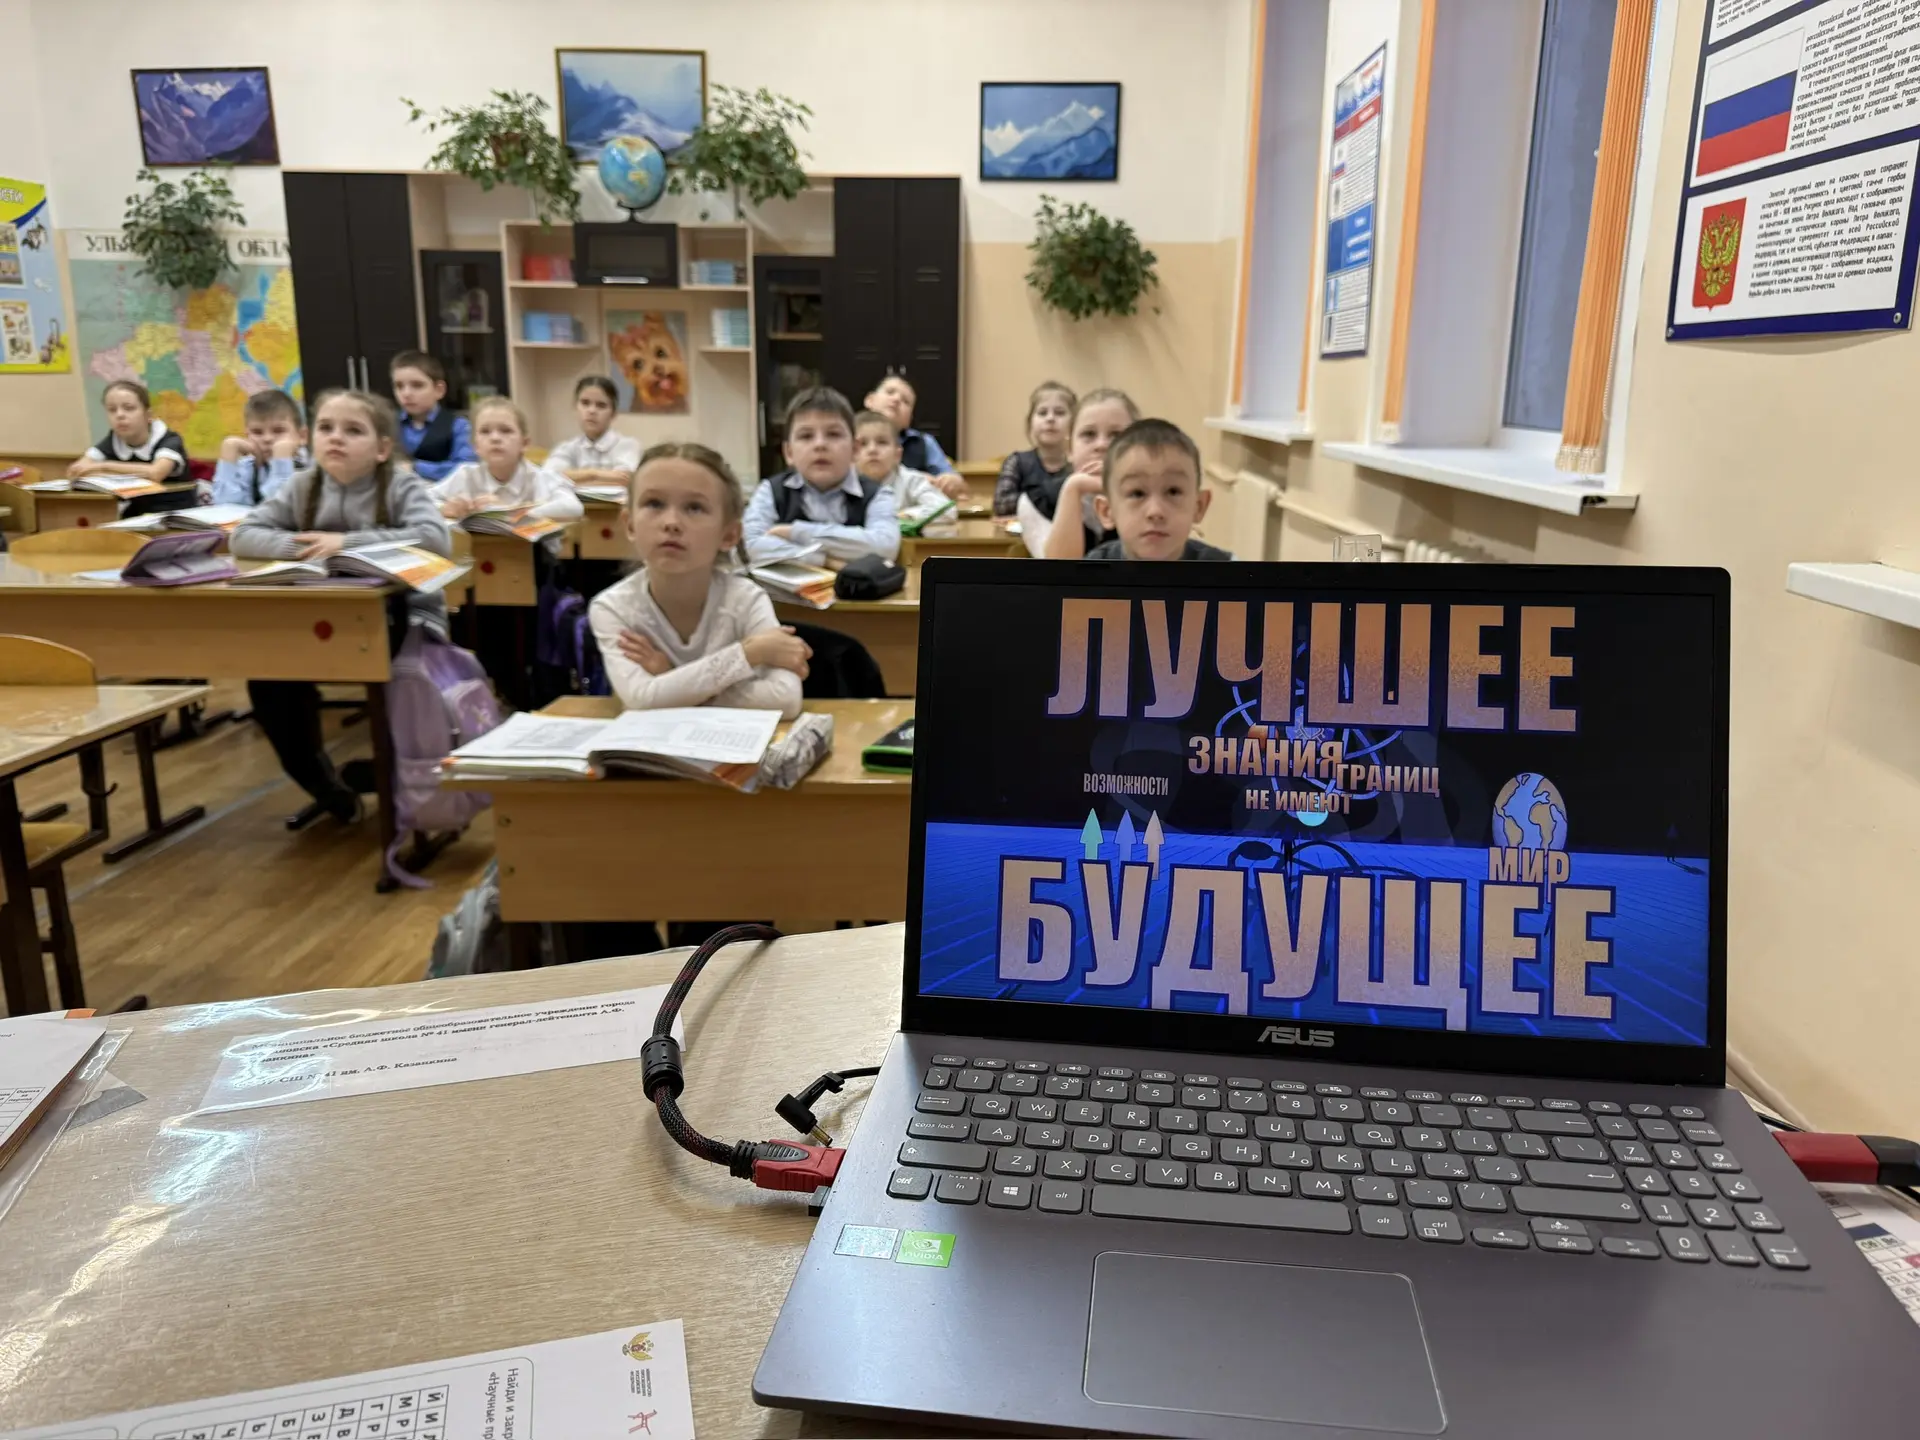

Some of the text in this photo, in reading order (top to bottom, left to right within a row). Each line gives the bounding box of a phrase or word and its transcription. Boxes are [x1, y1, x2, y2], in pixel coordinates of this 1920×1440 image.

[1047, 598, 1577, 732] ЛУЧШЕЕ
[1188, 735, 1343, 778] ЗНАНИЯ
[1083, 773, 1169, 796] ВОЗМОЖНОСТИ
[1336, 763, 1440, 797] ГРАНИЦ
[1245, 789, 1351, 815] НЕ ИМЕЮТ
[1000, 857, 1614, 1031] БУДУЩЕЕ
[1257, 1026, 1335, 1048] ASUS
[1127, 1111, 1136, 1119] R
[1088, 1134, 1099, 1142] D
[1138, 1138, 1146, 1146] F
[1185, 1142, 1198, 1150] G
[1236, 1146, 1247, 1154] H
[1289, 1151, 1295, 1159] J
[1626, 1147, 1635, 1155] 7
[1671, 1150, 1682, 1159] 8
[1011, 1156, 1022, 1165] Z
[1338, 1154, 1347, 1163] K
[1391, 1158, 1398, 1166] L
[1714, 1153, 1724, 1162] 9
[1061, 1160, 1071, 1169] X
[1111, 1164, 1122, 1173] C
[1162, 1168, 1172, 1176] V
[1214, 1172, 1223, 1180] B
[1264, 1176, 1276, 1184] N
[1644, 1175, 1654, 1183] 4
[1689, 1178, 1700, 1187] 5
[1316, 1181, 1331, 1189] M
[1735, 1182, 1745, 1190] 6
[1661, 1205, 1668, 1214] 1
[1707, 1208, 1719, 1218] 2
[1754, 1212, 1766, 1221] 3
[1679, 1237, 1690, 1248] 0
[504, 1368, 519, 1403] Найди
[425, 1392, 444, 1424] Й И
[482, 1371, 500, 1440] «Научные пр
[397, 1396, 413, 1427] М Р
[312, 1412, 326, 1422] З
[367, 1403, 384, 1432] Г Р
[282, 1418, 296, 1427] Б
[337, 1407, 355, 1438] Д В
[252, 1423, 266, 1433] Ь
[502, 1415, 515, 1440] закр
[221, 1428, 237, 1438] Ч
